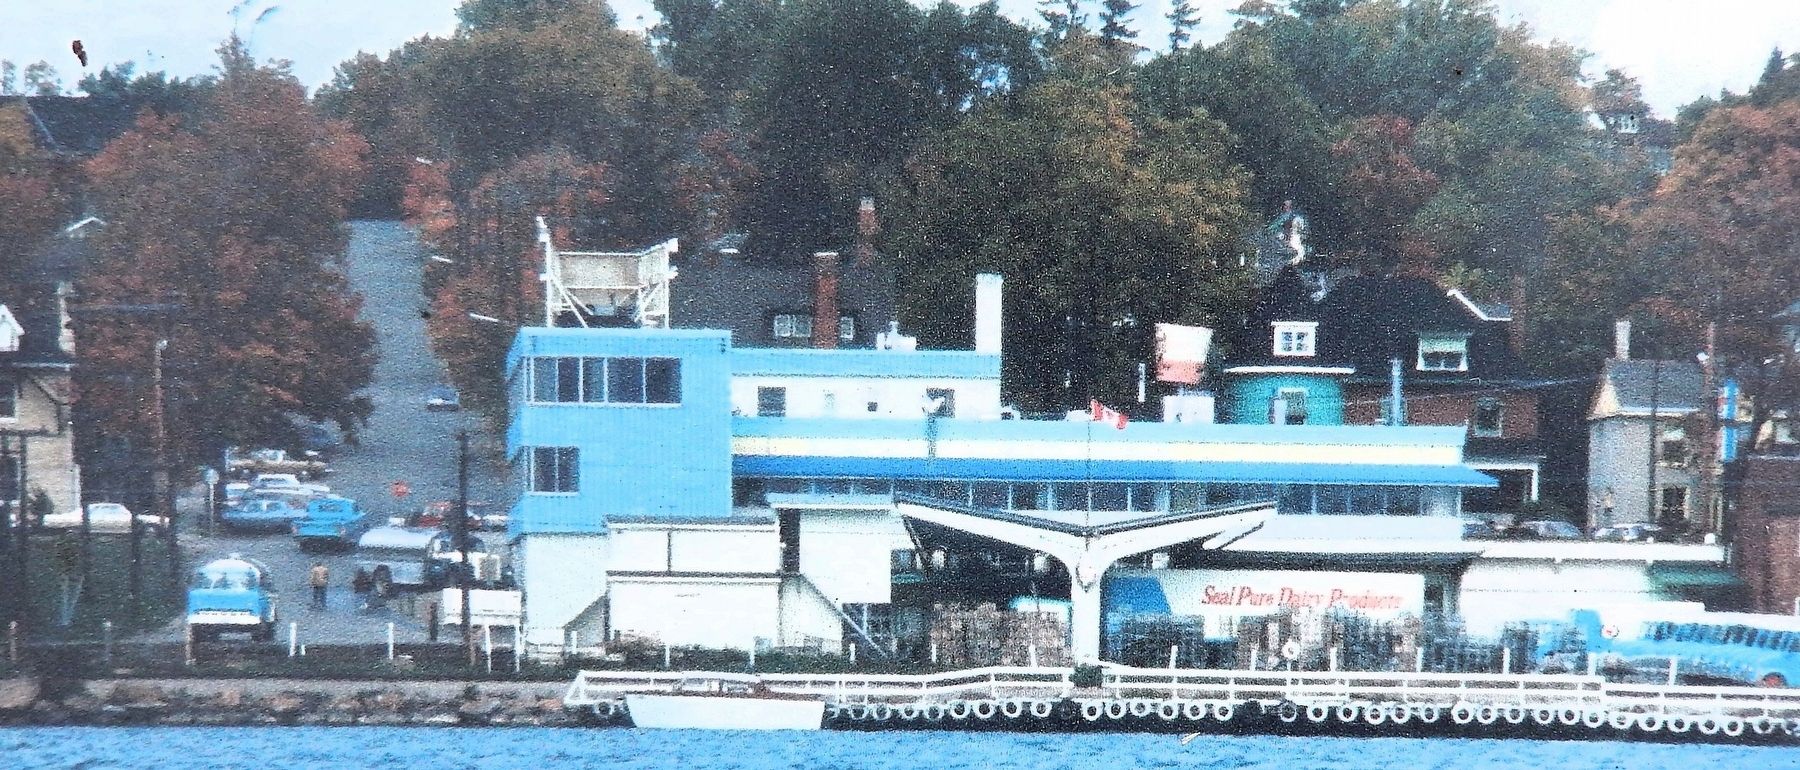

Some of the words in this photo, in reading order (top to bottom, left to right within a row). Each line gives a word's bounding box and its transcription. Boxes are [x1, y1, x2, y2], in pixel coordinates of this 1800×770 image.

[1201, 585, 1235, 605] Seal
[1236, 586, 1273, 606] Pure
[1278, 587, 1324, 609] Dairy
[1328, 588, 1403, 609] Products
